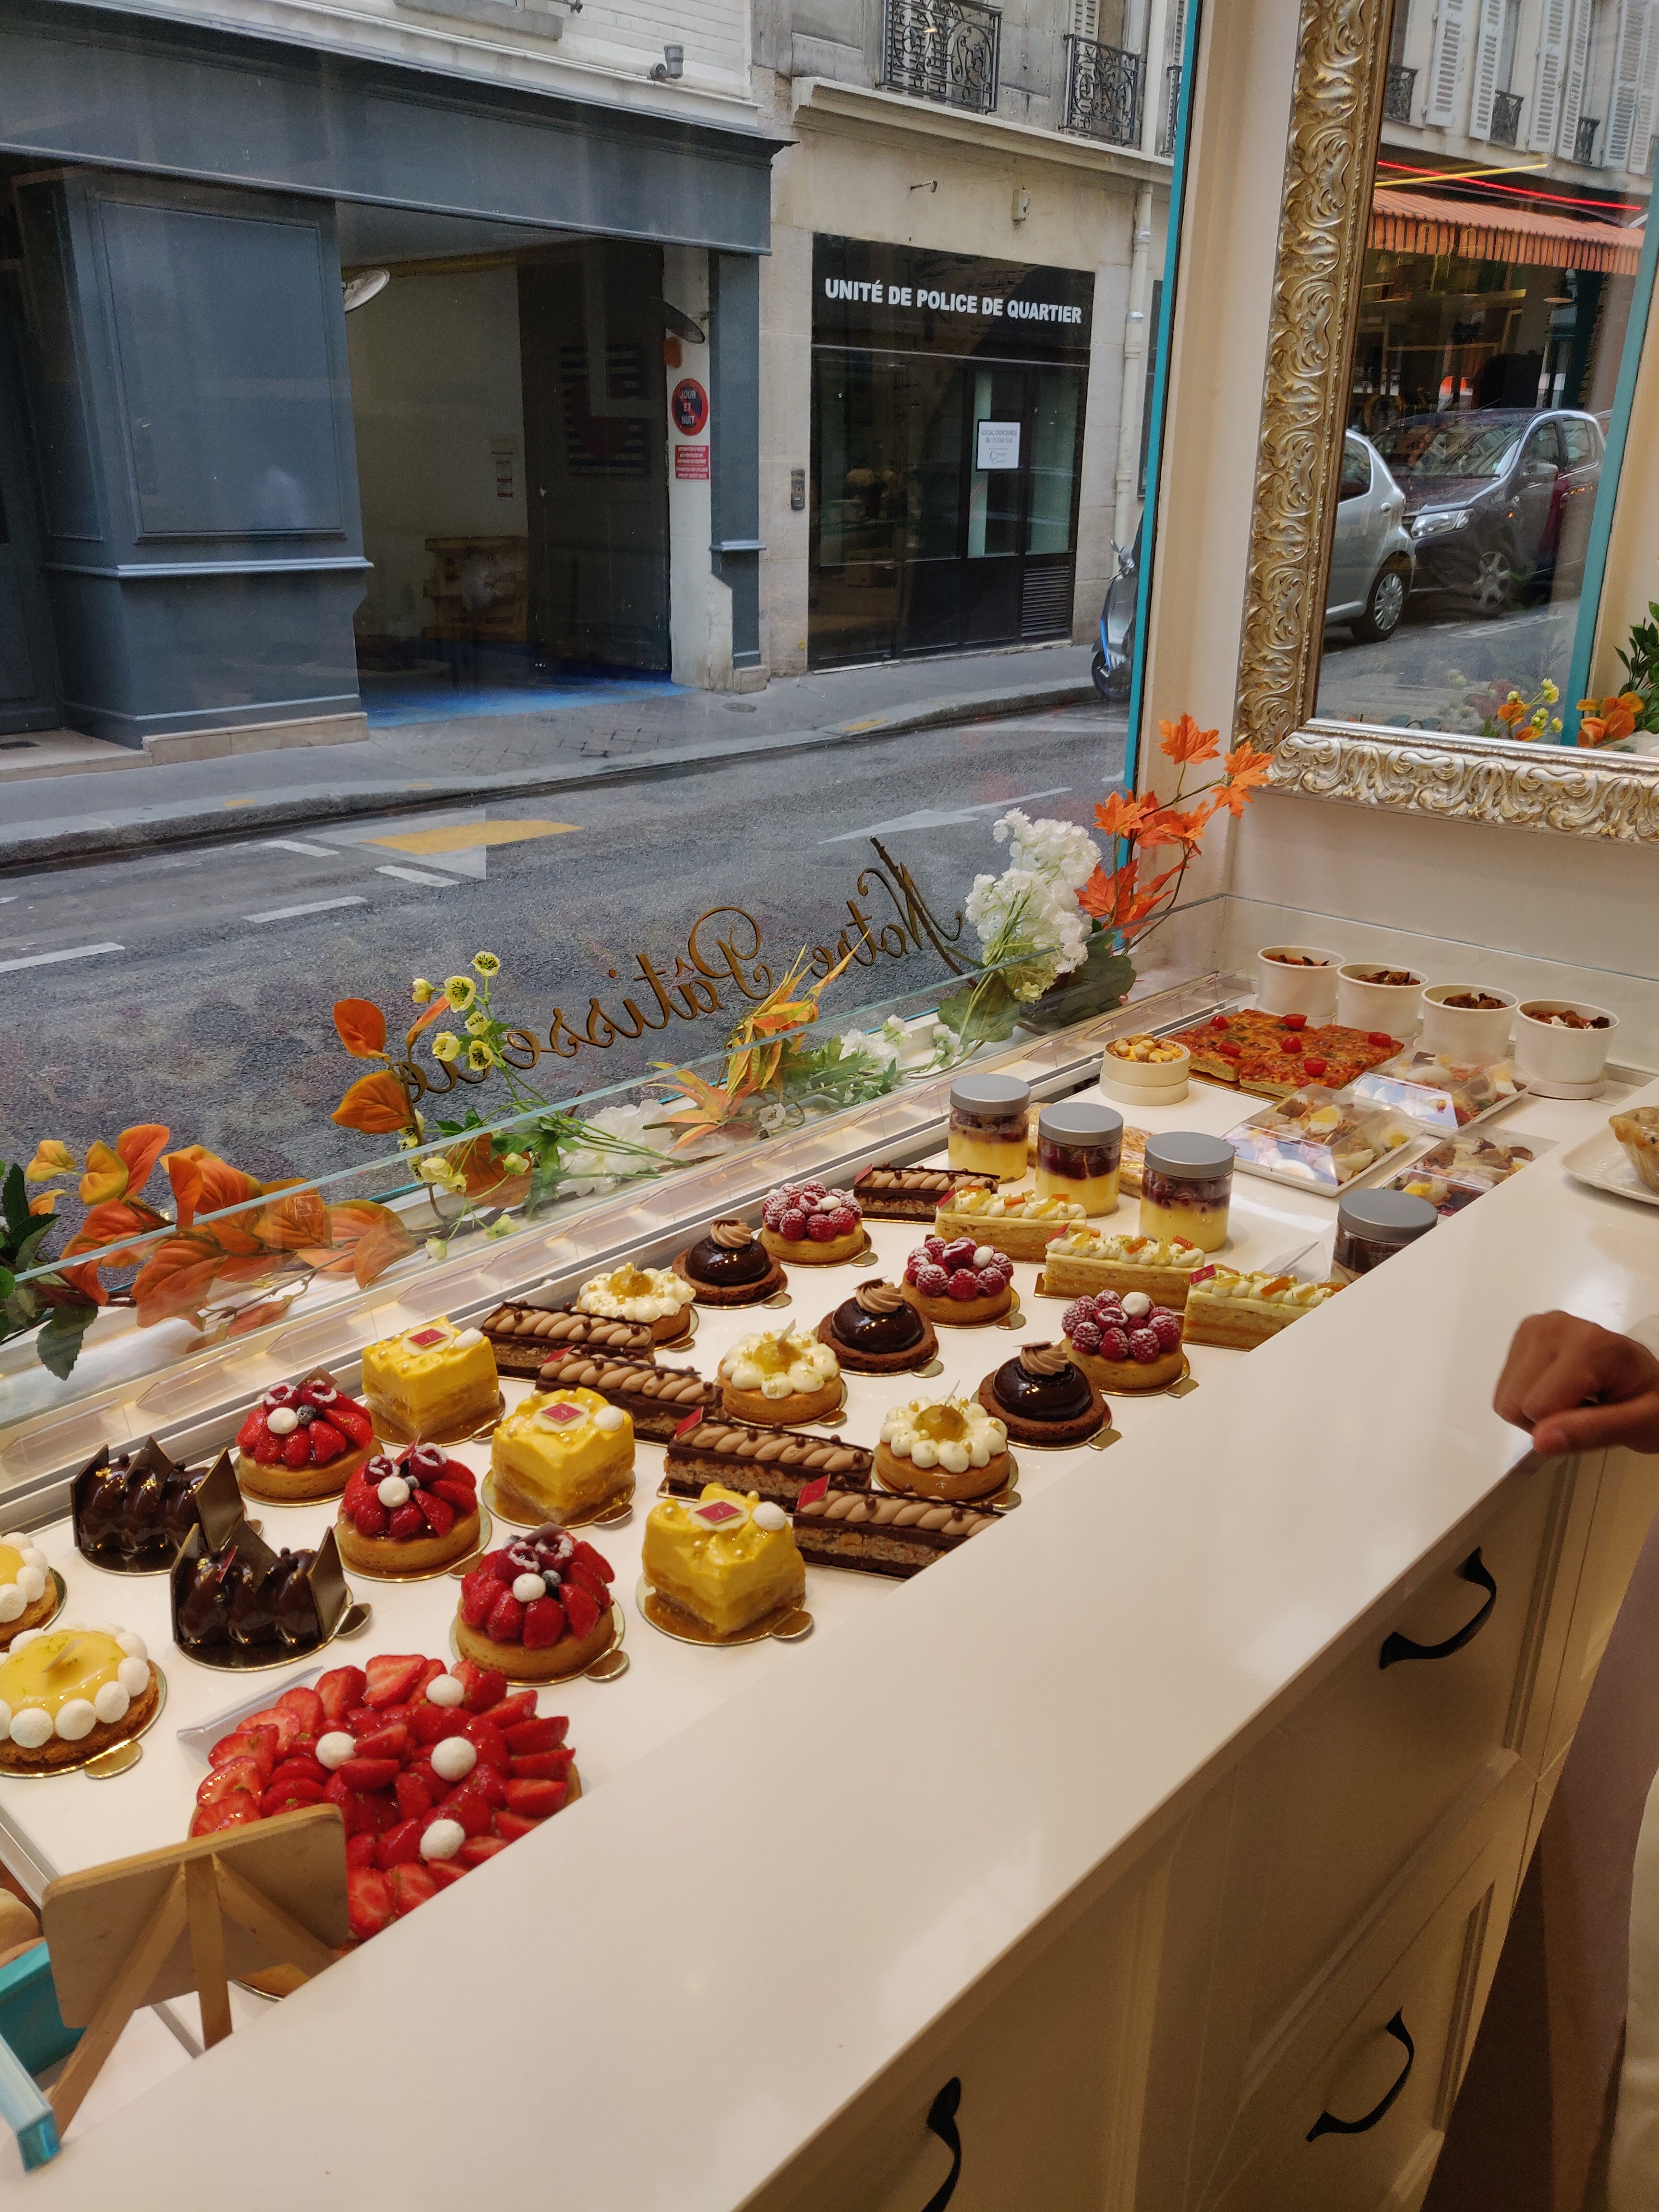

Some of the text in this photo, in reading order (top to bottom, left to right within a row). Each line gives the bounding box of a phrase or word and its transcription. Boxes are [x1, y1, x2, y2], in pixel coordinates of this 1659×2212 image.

[825, 278, 1082, 324] UNITÉ DE POLICE DE QUARTIER
[683, 402, 692, 412] ET
[681, 415, 695, 425] NUIT
